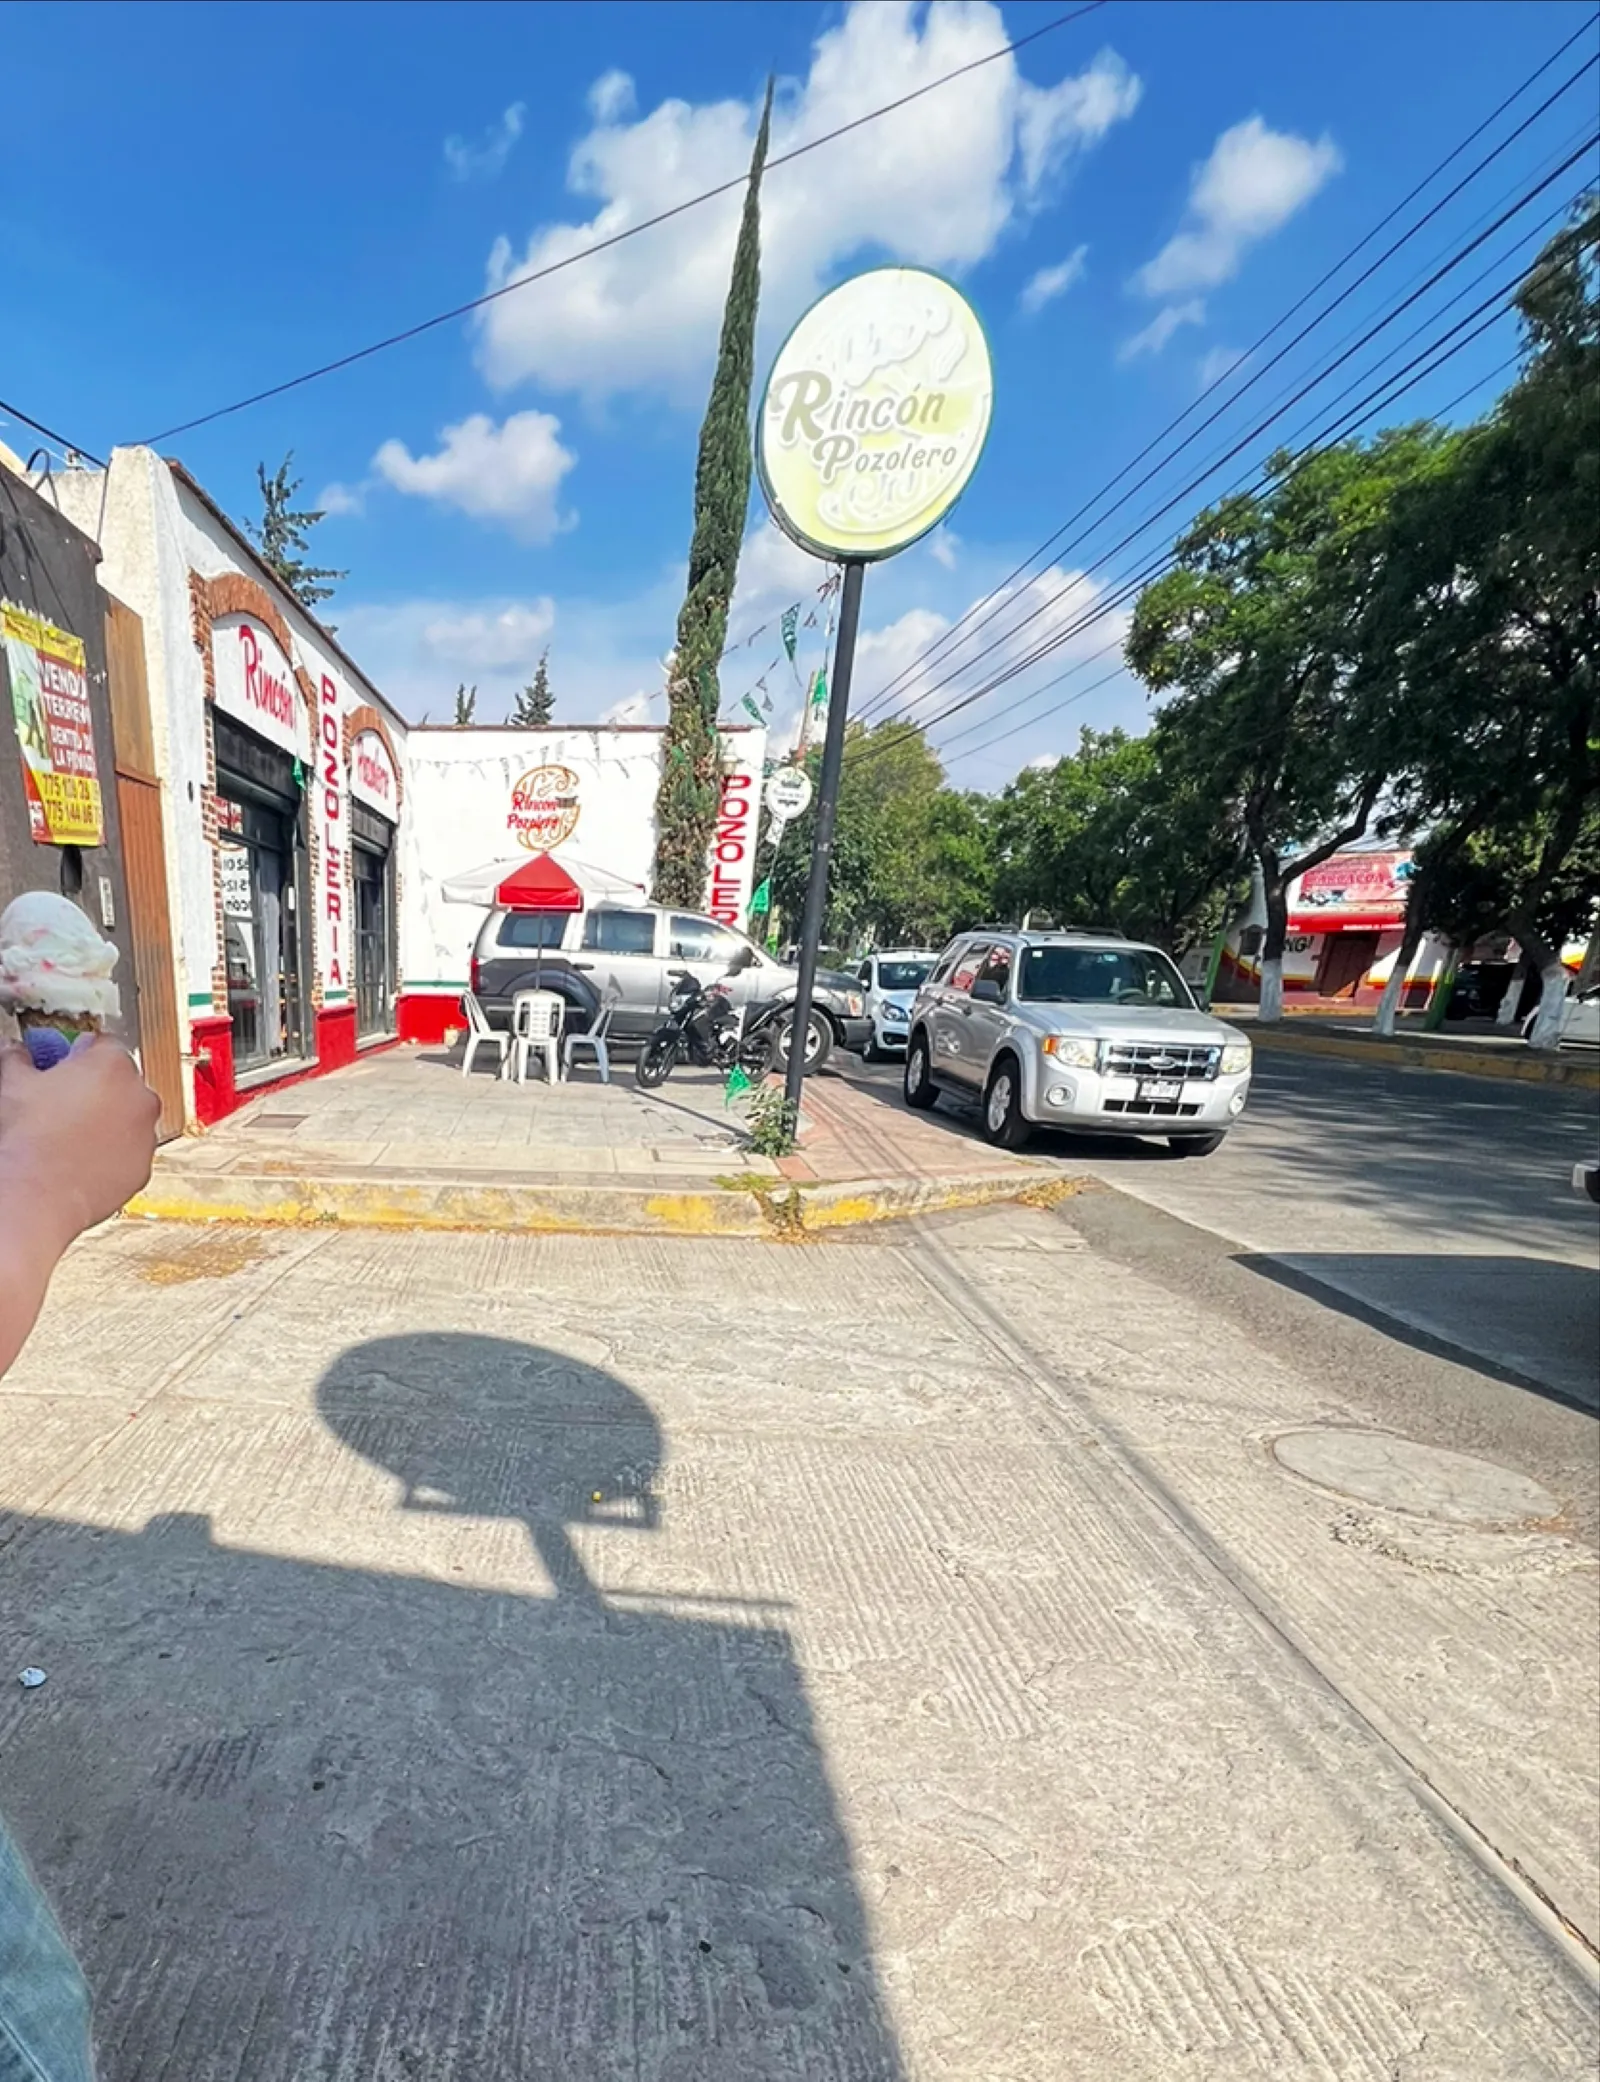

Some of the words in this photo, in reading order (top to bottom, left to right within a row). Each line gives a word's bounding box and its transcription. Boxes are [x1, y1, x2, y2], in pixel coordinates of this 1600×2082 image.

[769, 370, 946, 442] Rincón
[813, 435, 957, 481] Pozolero
[239, 624, 294, 730] Rincón
[320, 673, 342, 986] POZOLERIA
